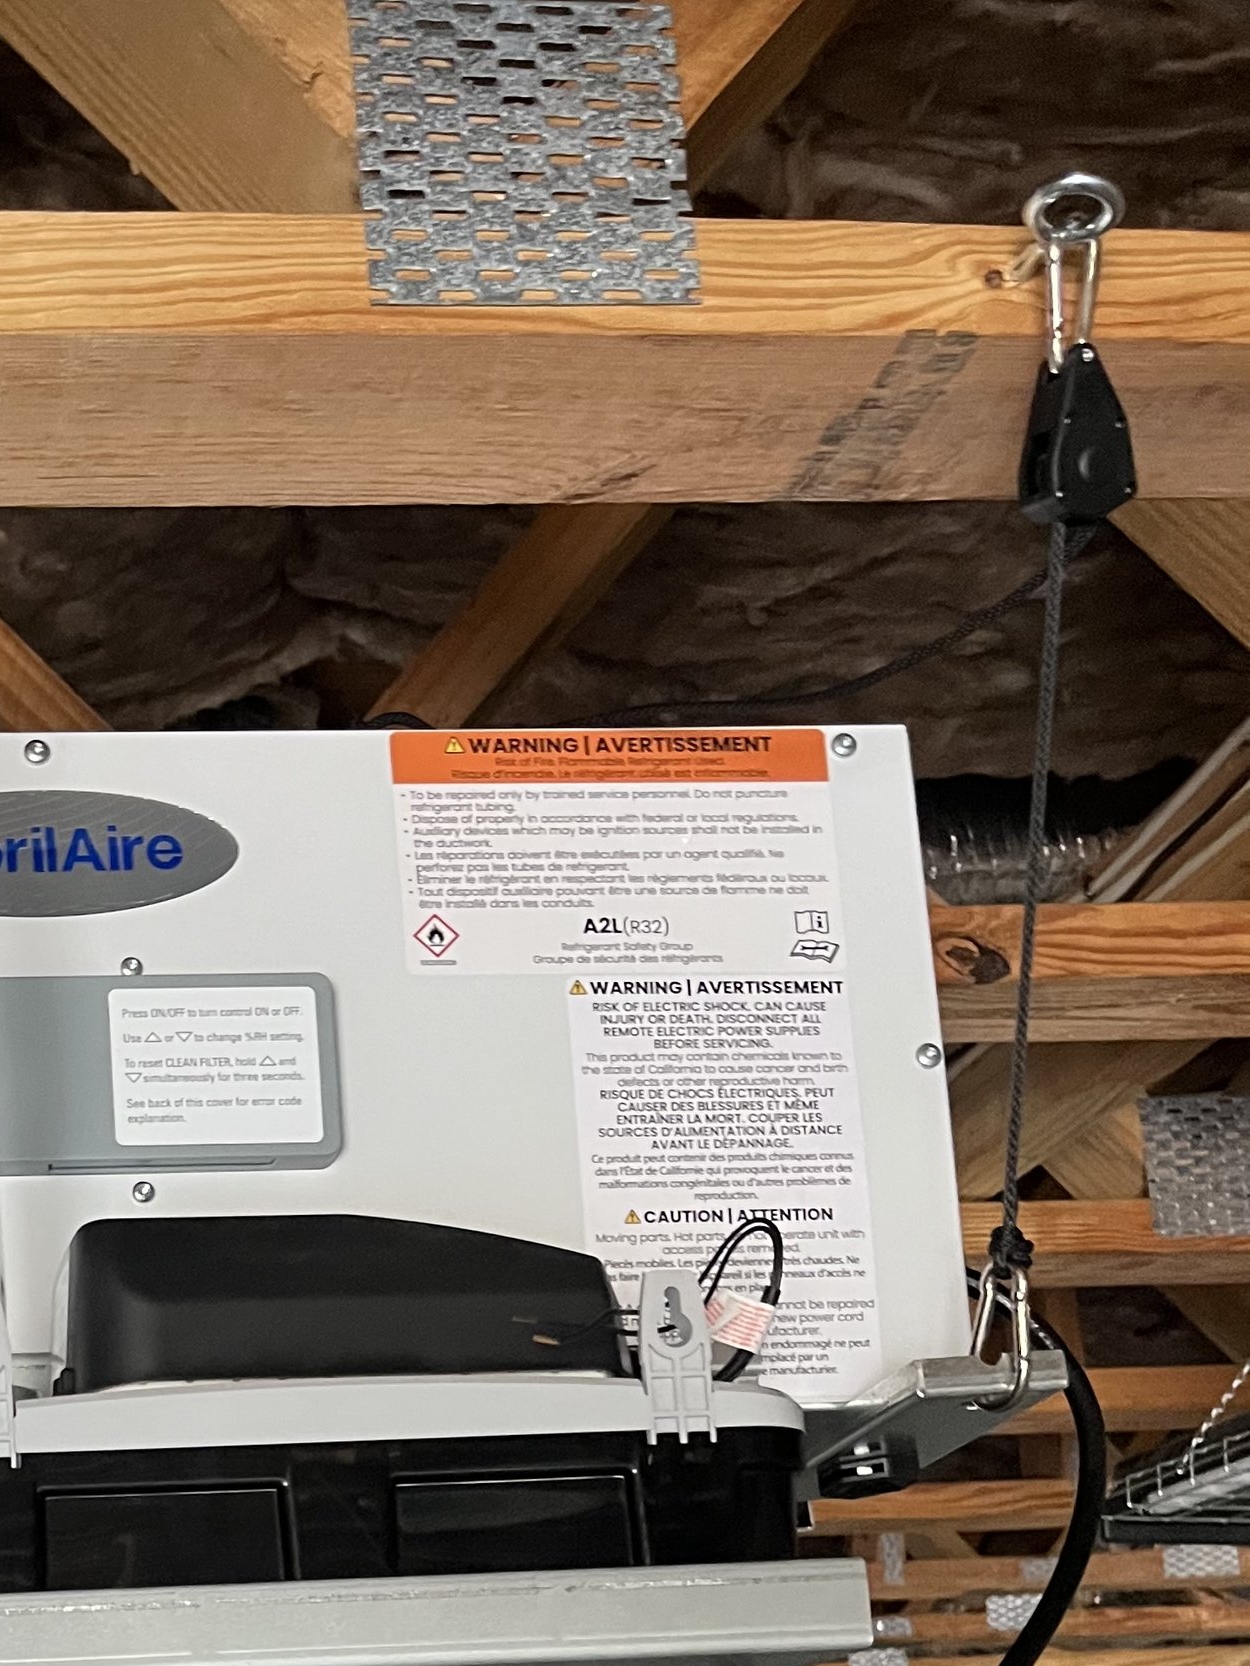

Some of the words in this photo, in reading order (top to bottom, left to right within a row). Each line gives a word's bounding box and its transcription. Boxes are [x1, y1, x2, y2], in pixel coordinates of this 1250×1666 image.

[590, 982, 681, 994] WARNING
[697, 982, 843, 994] AVERTISSEMENT
[592, 1003, 619, 1011] RISK
[622, 1003, 639, 1011] OF
[642, 1003, 700, 1011] ELECTRIC
[754, 1003, 782, 1011] CAN
[785, 1003, 826, 1011] CAUSE
[599, 1015, 644, 1023] INJURY
[647, 1015, 665, 1023] OR
[669, 1015, 712, 1023] DEATH.
[716, 1015, 796, 1023] DISCONNECT
[801, 1015, 820, 1023] ALL
[603, 1028, 652, 1036] REMOTE
[656, 1028, 714, 1036] ELECTRIC
[717, 1027, 762, 1035] POWER
[765, 1027, 820, 1035] SUPPLIES
[653, 1040, 699, 1048] BEFORE
[703, 1040, 772, 1048] SERVICING.
[644, 1210, 723, 1223] CAUTION
[737, 1209, 832, 1222] ATTENTION
